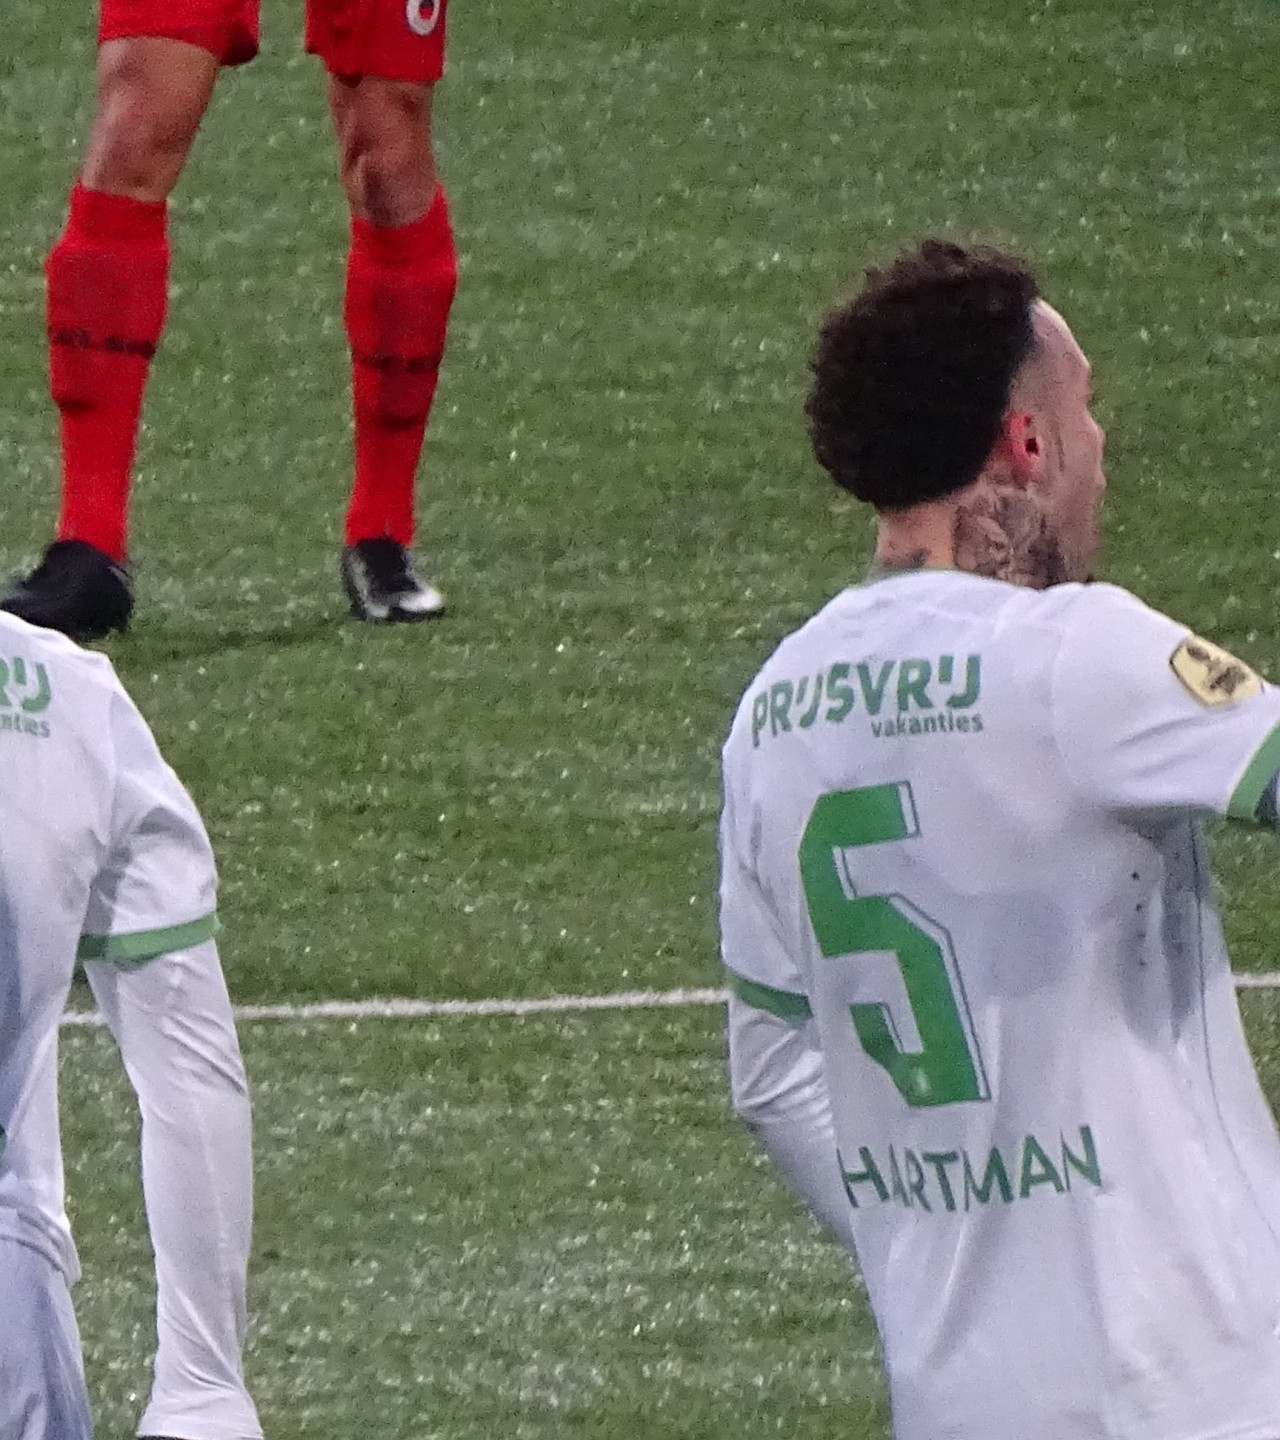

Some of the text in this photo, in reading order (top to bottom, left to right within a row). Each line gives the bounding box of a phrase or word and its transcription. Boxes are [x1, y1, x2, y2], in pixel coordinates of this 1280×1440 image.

[870, 709, 984, 738] vakanties
[798, 780, 992, 1108] 5
[836, 1124, 1103, 1214] HARTMAN
